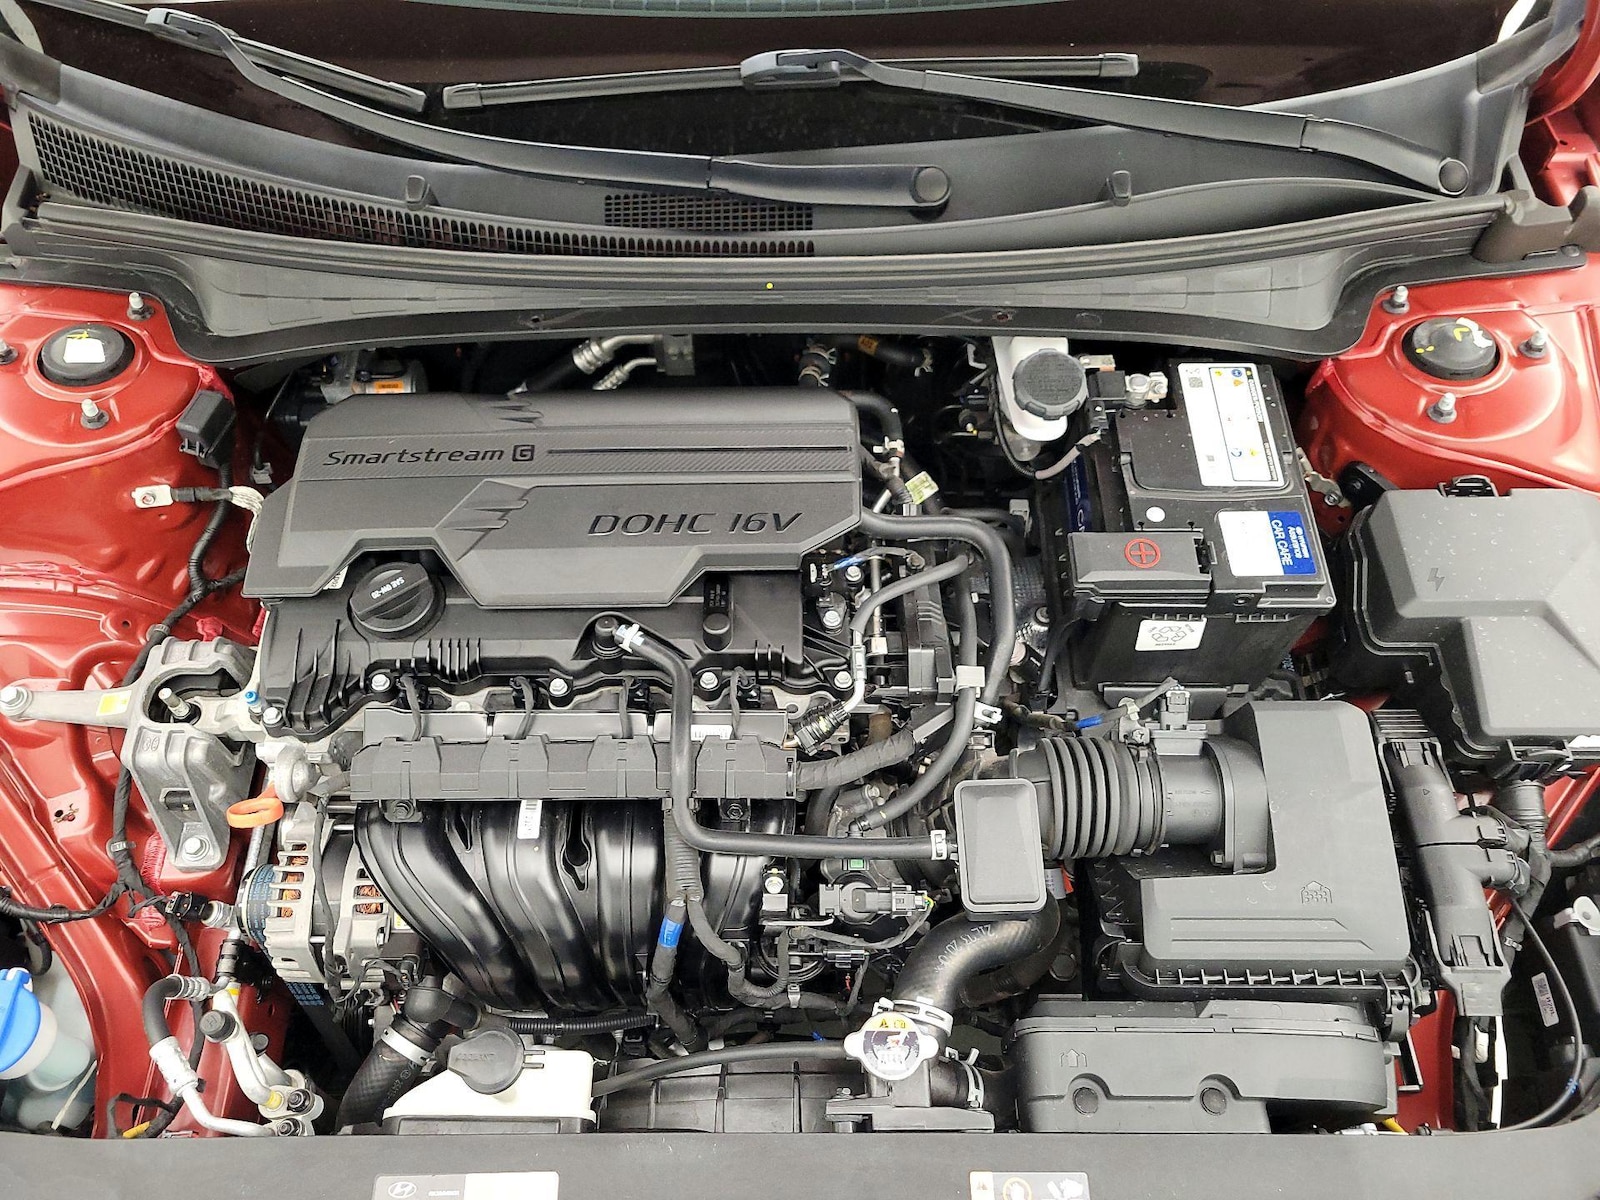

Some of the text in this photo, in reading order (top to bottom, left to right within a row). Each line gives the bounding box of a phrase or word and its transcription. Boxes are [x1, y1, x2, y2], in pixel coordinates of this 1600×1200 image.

[323, 447, 504, 466] Smartstream
[587, 512, 803, 536] DOHC 16V
[1271, 519, 1294, 566] CAR CARE
[370, 576, 405, 600] SAE 0W-20
